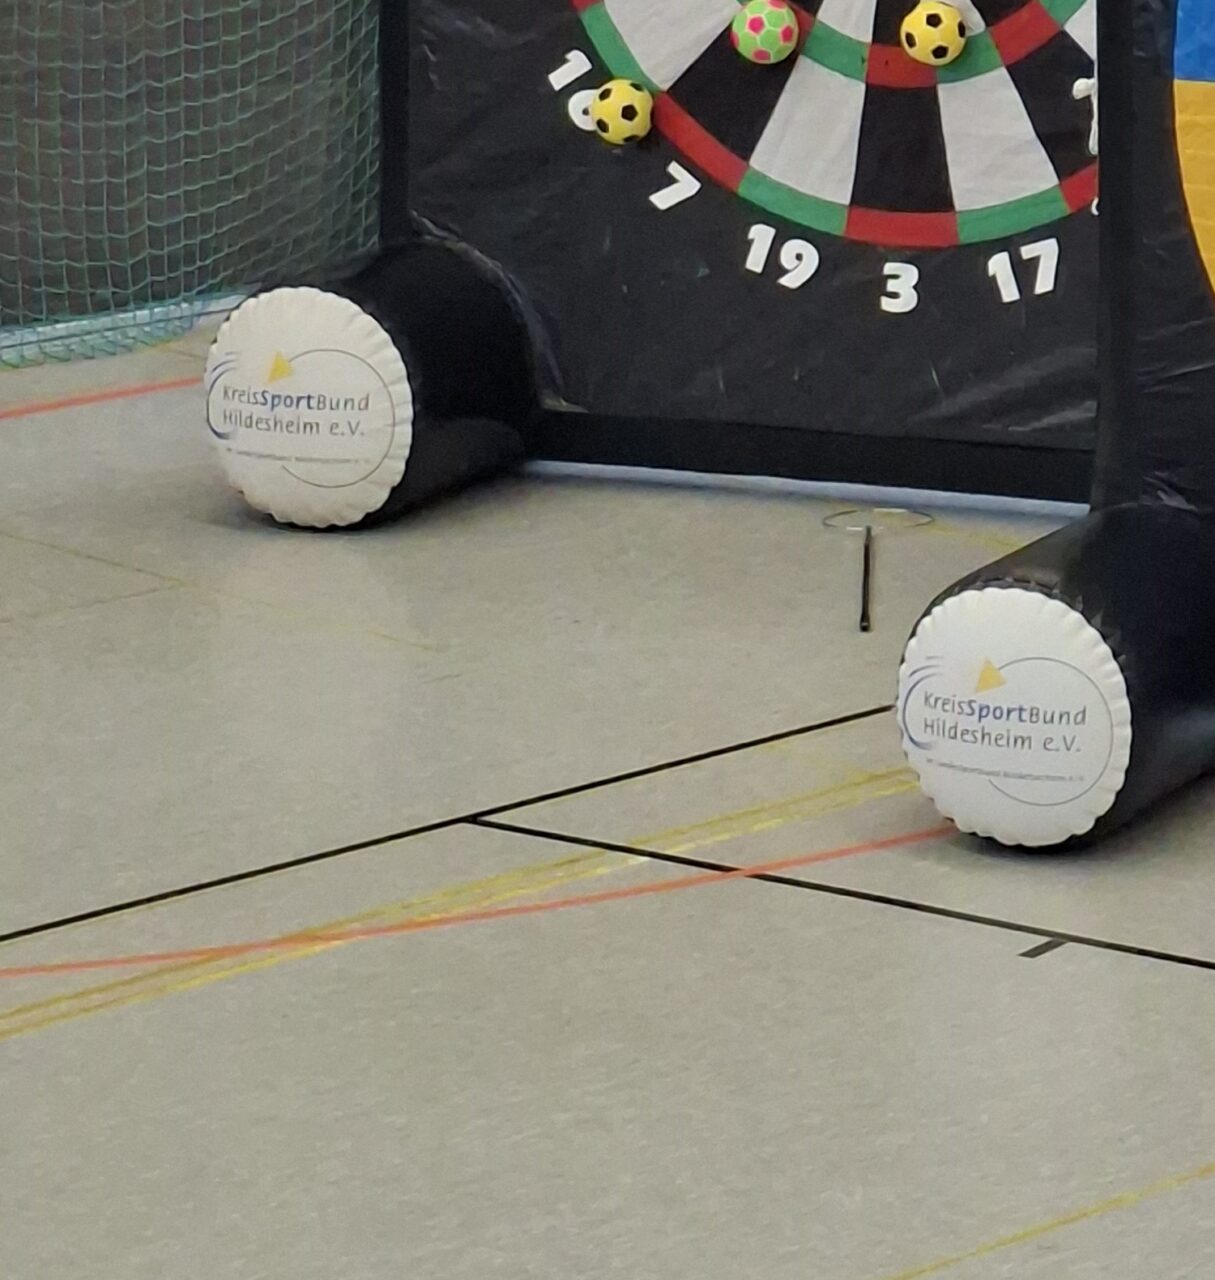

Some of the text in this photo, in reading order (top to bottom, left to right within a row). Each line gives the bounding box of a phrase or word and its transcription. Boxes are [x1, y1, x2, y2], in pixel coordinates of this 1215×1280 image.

[647, 159, 703, 212] 7
[744, 222, 821, 290] 19
[986, 236, 1060, 304] 17
[879, 260, 920, 314] 3
[222, 384, 371, 412] KreisSportBund
[222, 407, 366, 437] Hildesheim e.V.
[923, 690, 1088, 727] KreisSportBund
[923, 717, 1083, 753] Hildesheim e.V.
